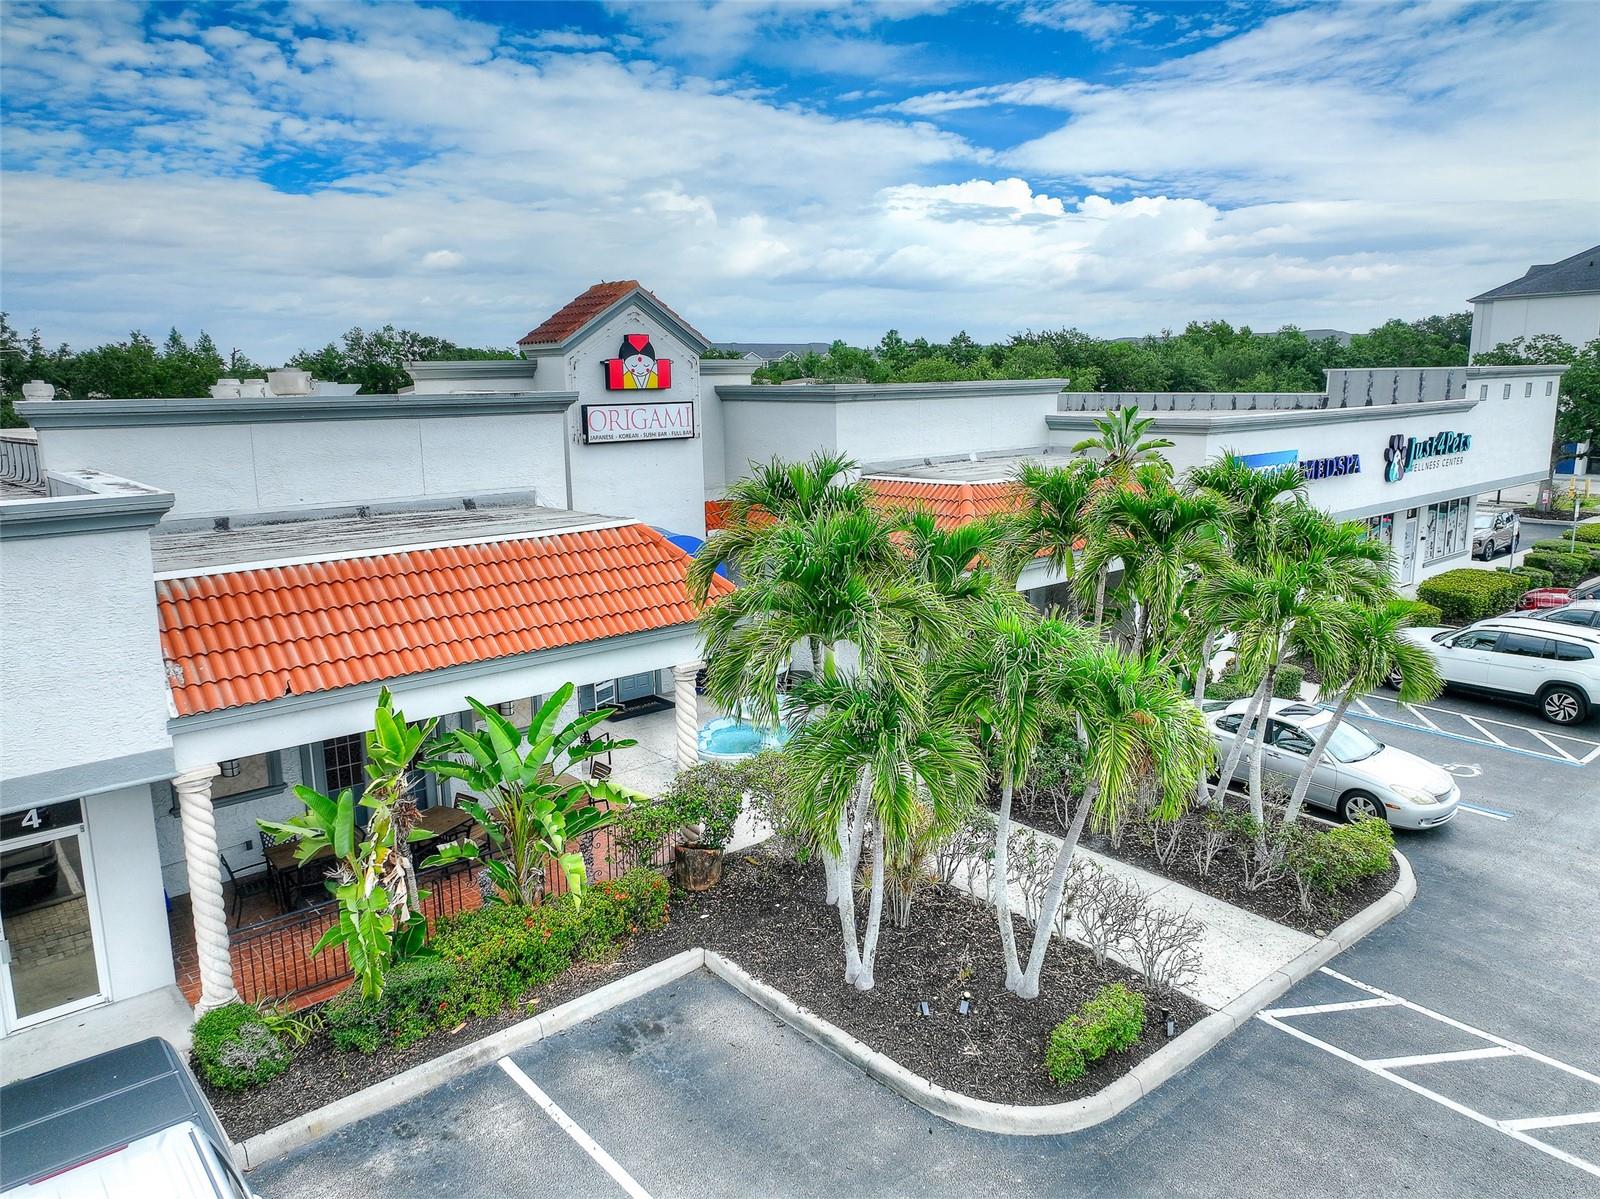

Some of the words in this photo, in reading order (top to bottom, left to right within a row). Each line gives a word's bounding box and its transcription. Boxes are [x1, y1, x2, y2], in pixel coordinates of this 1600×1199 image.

[588, 406, 691, 432] ORIGAMI
[1404, 431, 1471, 473] Just4Pets
[1411, 459, 1440, 472] ELLNESS
[1442, 456, 1464, 468] CENTER
[1300, 454, 1360, 480] MEDSPA
[21, 808, 42, 828] 4
